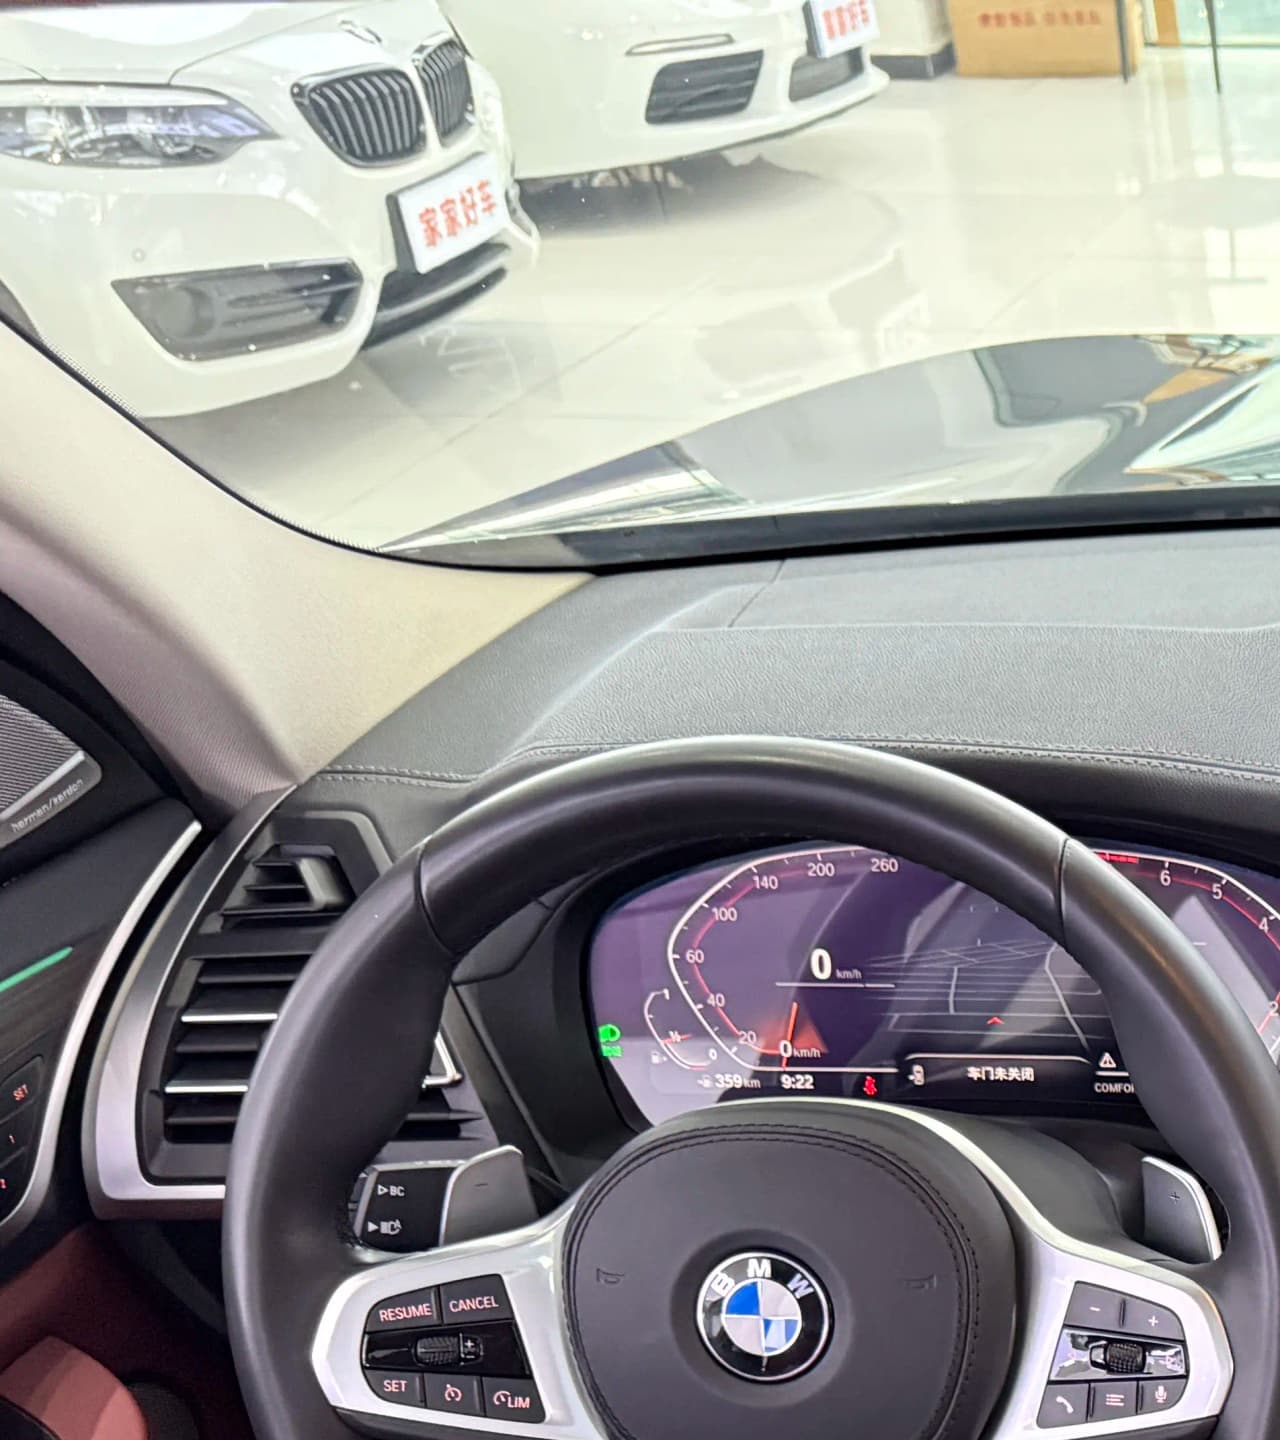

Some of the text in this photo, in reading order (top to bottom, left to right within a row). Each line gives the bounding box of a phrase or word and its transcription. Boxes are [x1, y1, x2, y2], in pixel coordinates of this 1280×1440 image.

[807, 863, 835, 877] 200
[870, 858, 899, 873] 260
[753, 875, 778, 889] 140
[1160, 871, 1171, 886] 6
[1212, 884, 1222, 900] 5
[711, 906, 737, 922] 100
[1258, 917, 1269, 932] 4
[686, 949, 704, 963] 60
[810, 948, 862, 980] 0 km/h
[706, 993, 726, 1008] 40
[1268, 1001, 1279, 1016] 2
[739, 1031, 757, 1045] 20
[779, 1039, 822, 1059] 0 km/h
[714, 1074, 761, 1089] 359 km
[967, 1066, 1035, 1082] 车门未关闭
[780, 1074, 815, 1090] 9:22
[389, 1185, 405, 1197] BC
[710, 1258, 815, 1299] BMW
[449, 1295, 499, 1313] CANCEL
[379, 1303, 433, 1322] RESUME
[383, 1379, 408, 1392] SET
[507, 1396, 531, 1409] LIM
